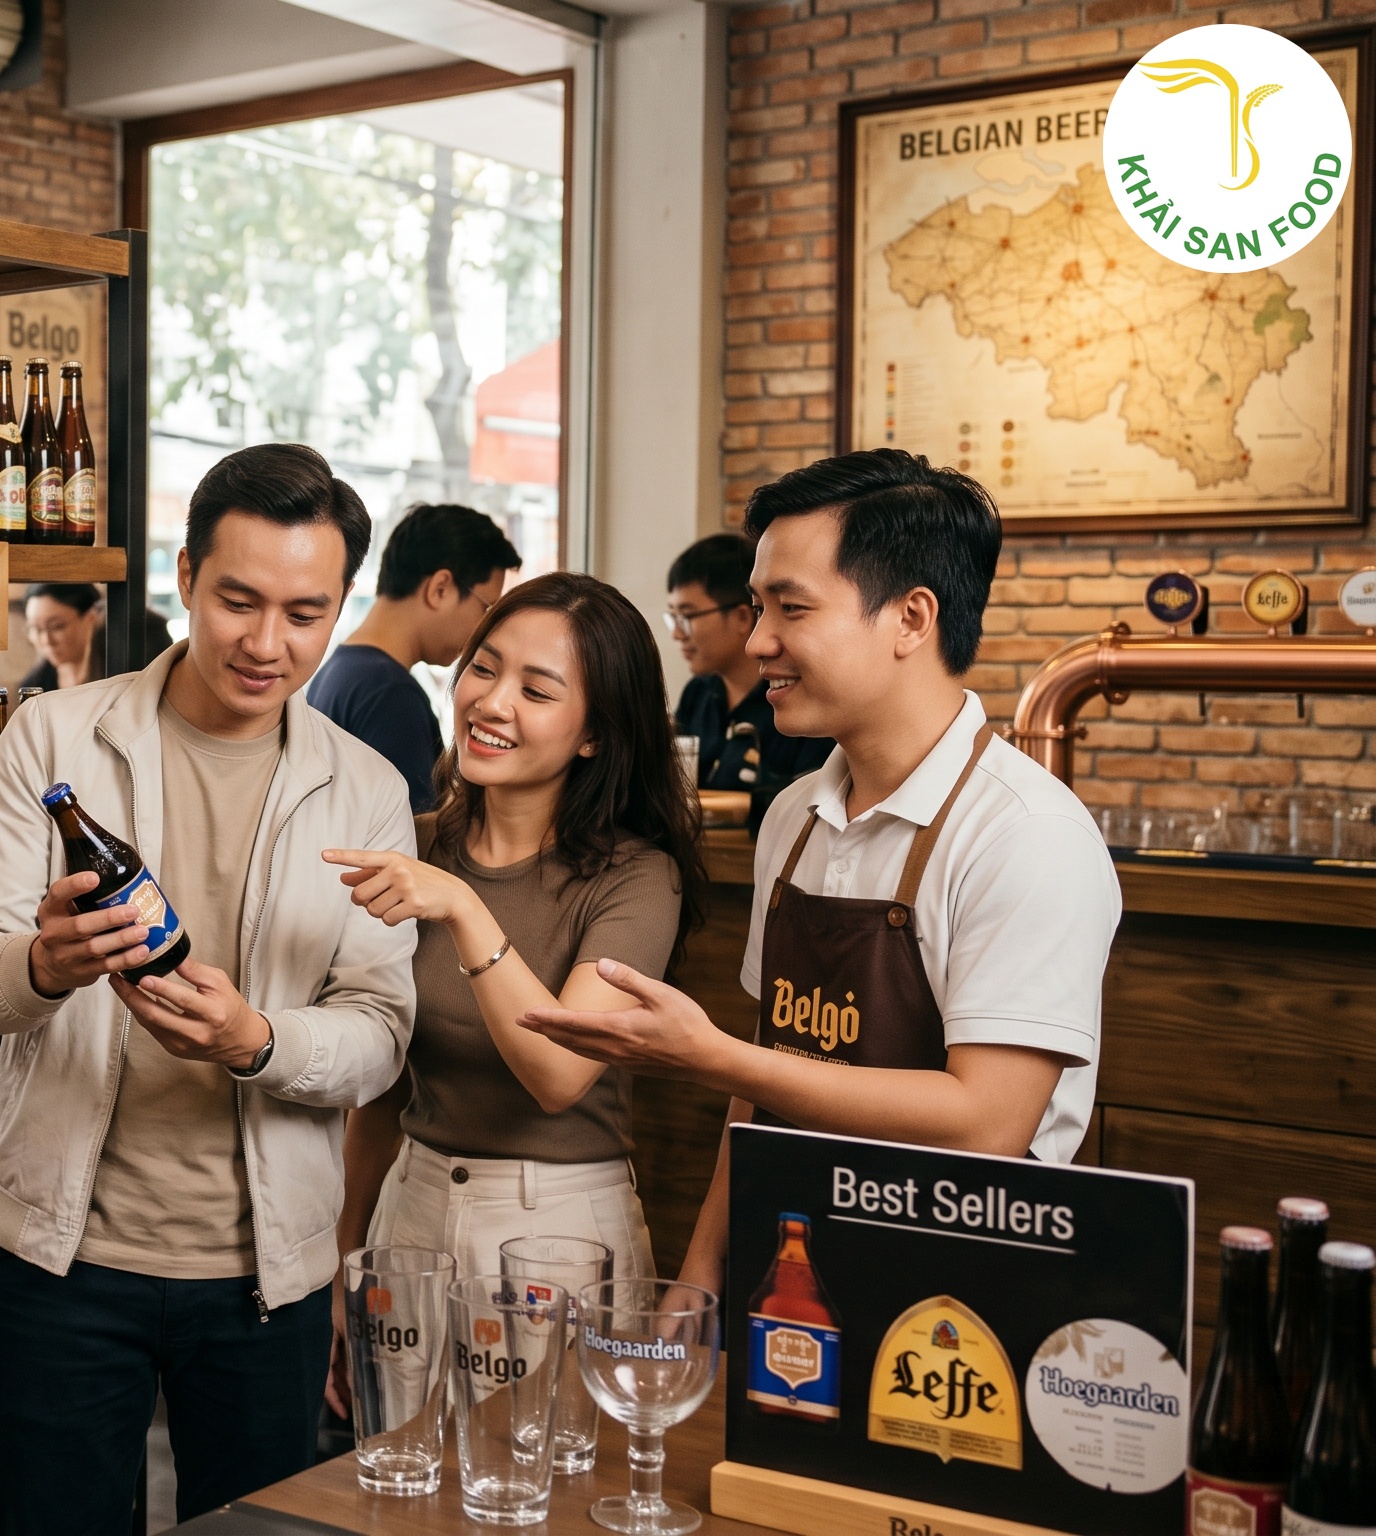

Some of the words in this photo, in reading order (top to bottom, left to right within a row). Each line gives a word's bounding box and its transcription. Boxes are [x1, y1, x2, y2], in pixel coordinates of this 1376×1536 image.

[899, 118, 1023, 161] BELGIAN
[1036, 108, 1109, 144] BEER
[7, 310, 80, 362] Belgo
[831, 1165, 920, 1220] Best
[931, 1178, 1075, 1242] Sellers
[455, 1339, 528, 1385] Belgo
[584, 1324, 687, 1362] Hoegaarden
[888, 1349, 999, 1421] Leffe
[1038, 1365, 1181, 1418] Hoegaarden
